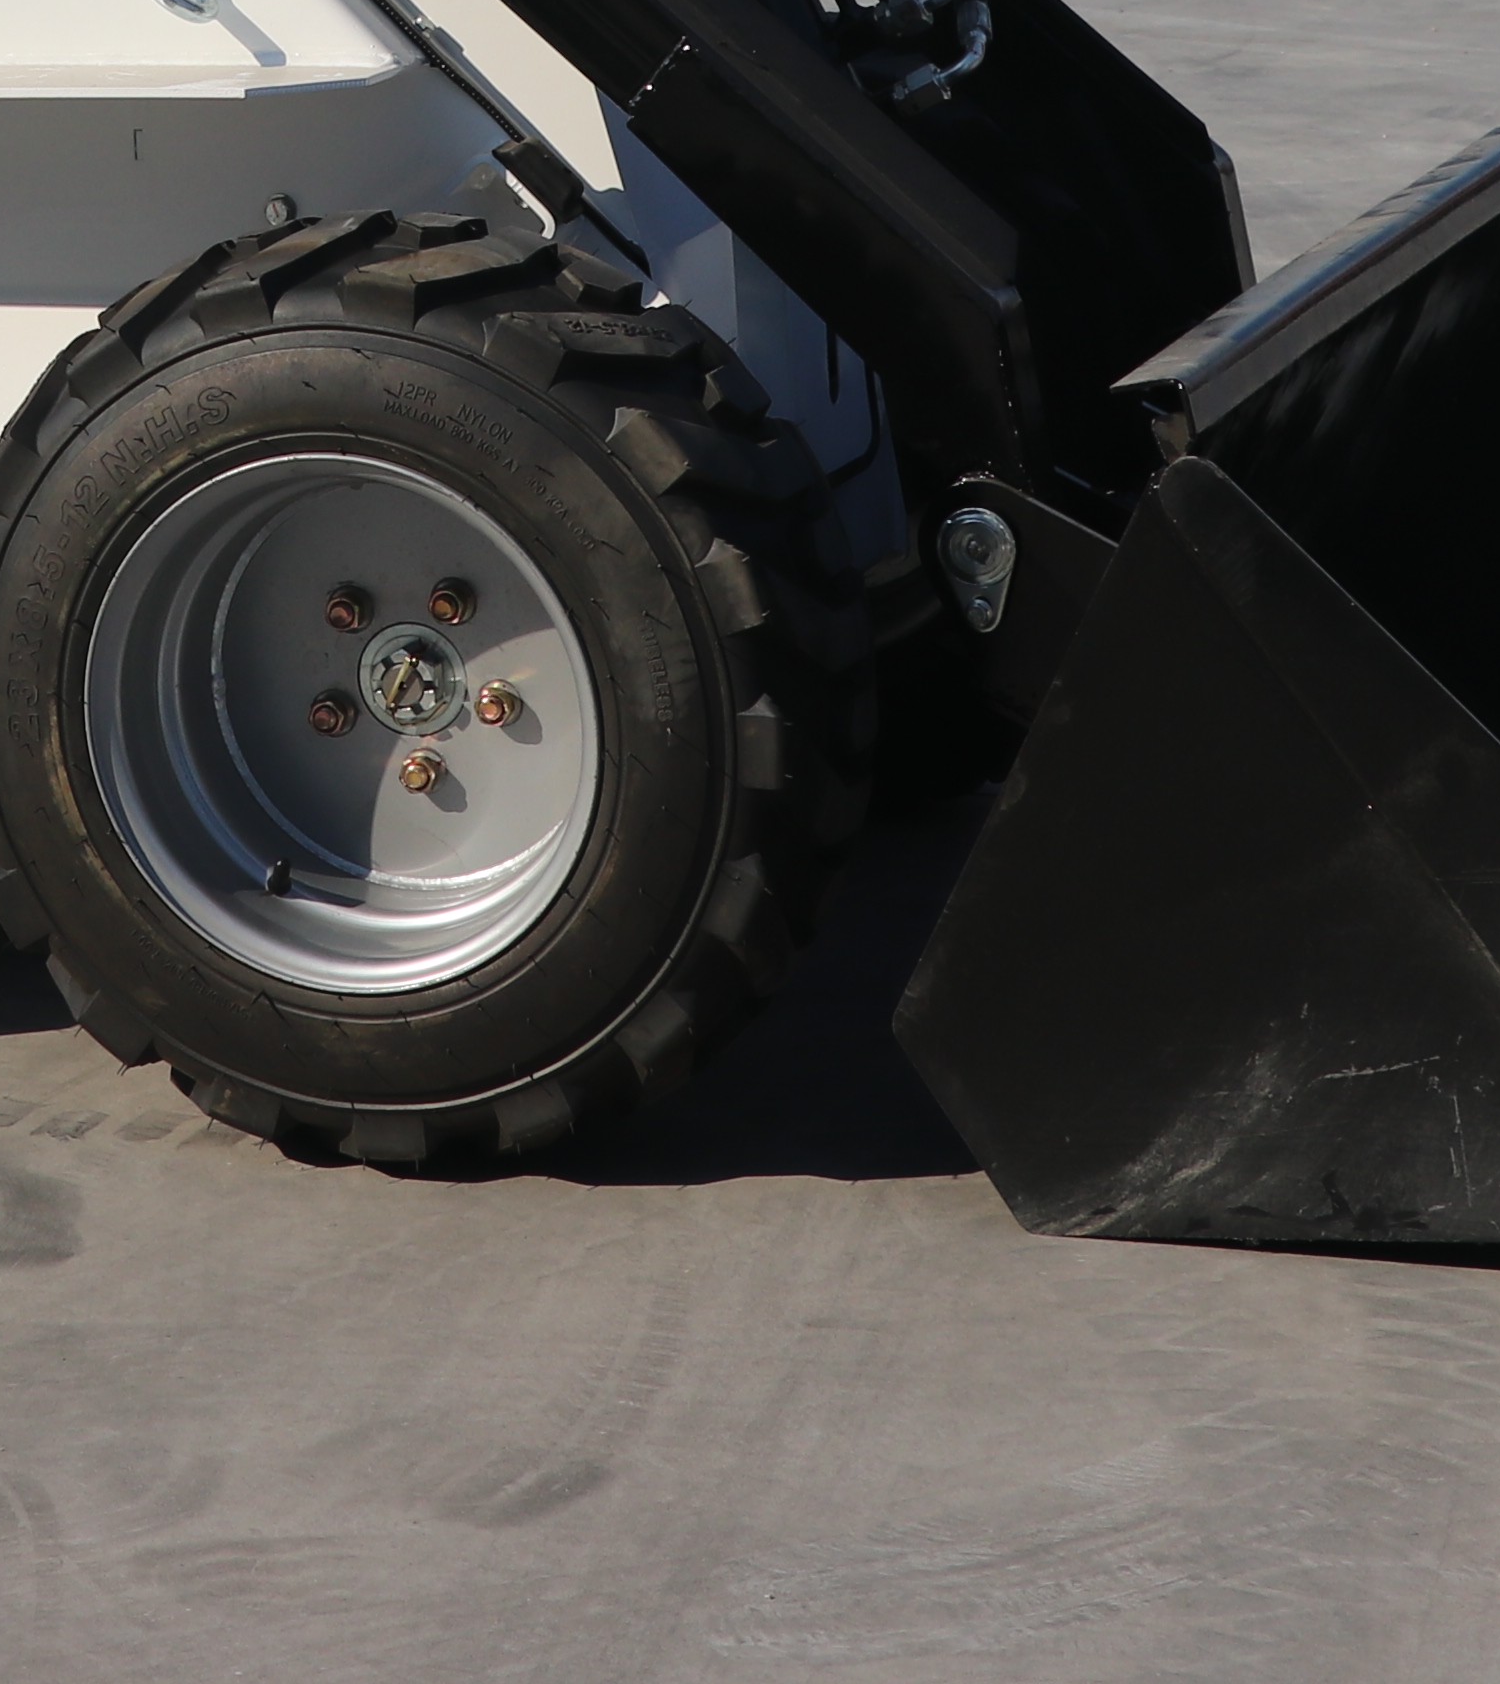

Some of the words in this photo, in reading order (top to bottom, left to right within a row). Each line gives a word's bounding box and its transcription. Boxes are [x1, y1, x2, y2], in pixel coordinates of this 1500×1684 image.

[396, 380, 438, 408] 12PR
[455, 402, 514, 446] NYLON
[476, 437, 503, 462] KGS
